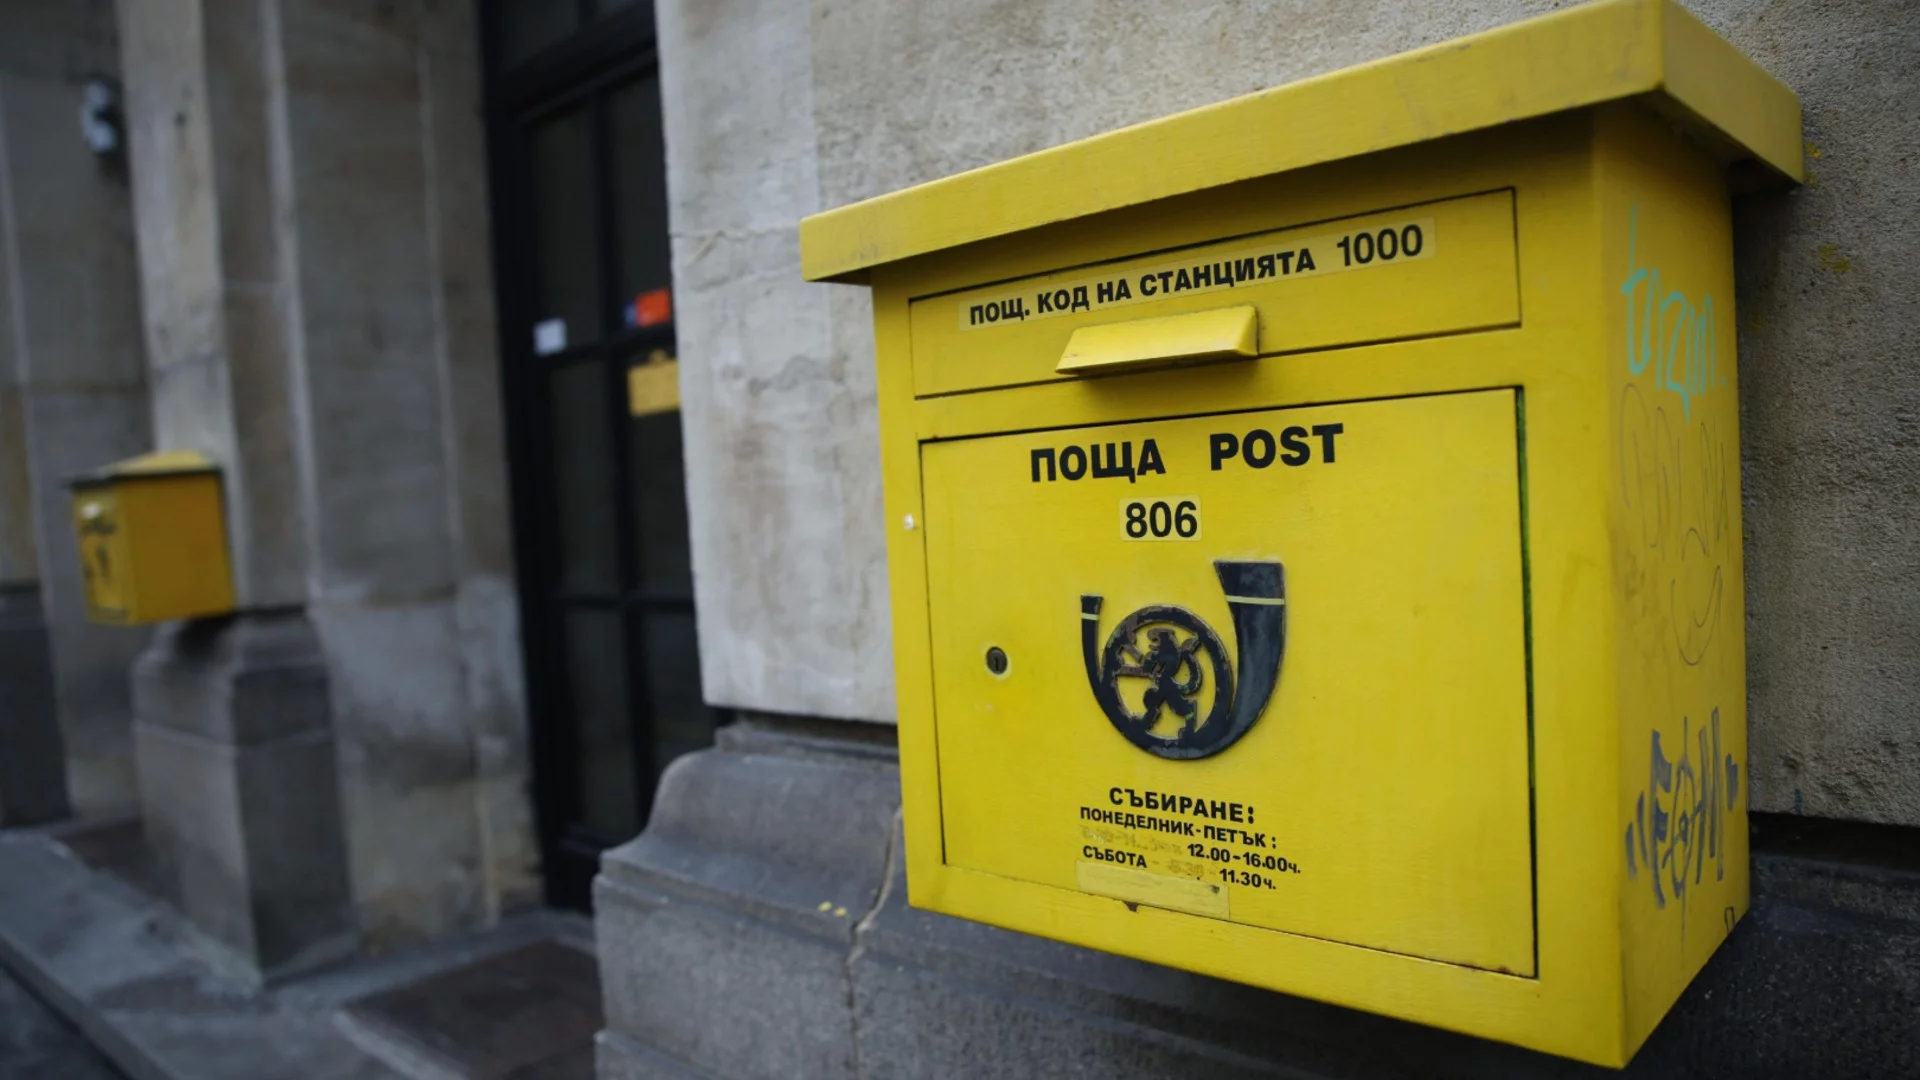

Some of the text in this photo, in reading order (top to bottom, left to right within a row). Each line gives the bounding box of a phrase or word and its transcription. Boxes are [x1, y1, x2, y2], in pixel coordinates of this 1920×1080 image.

[970, 224, 1423, 325] ПОЩ. КОД НА СТАНЦИЯТА 1000
[1031, 423, 1344, 484] ПОЩА POST
[1126, 501, 1198, 538] 806
[1109, 787, 1254, 825] СЪБИРАНЕ:
[1082, 845, 1148, 869] СЪБОТА
